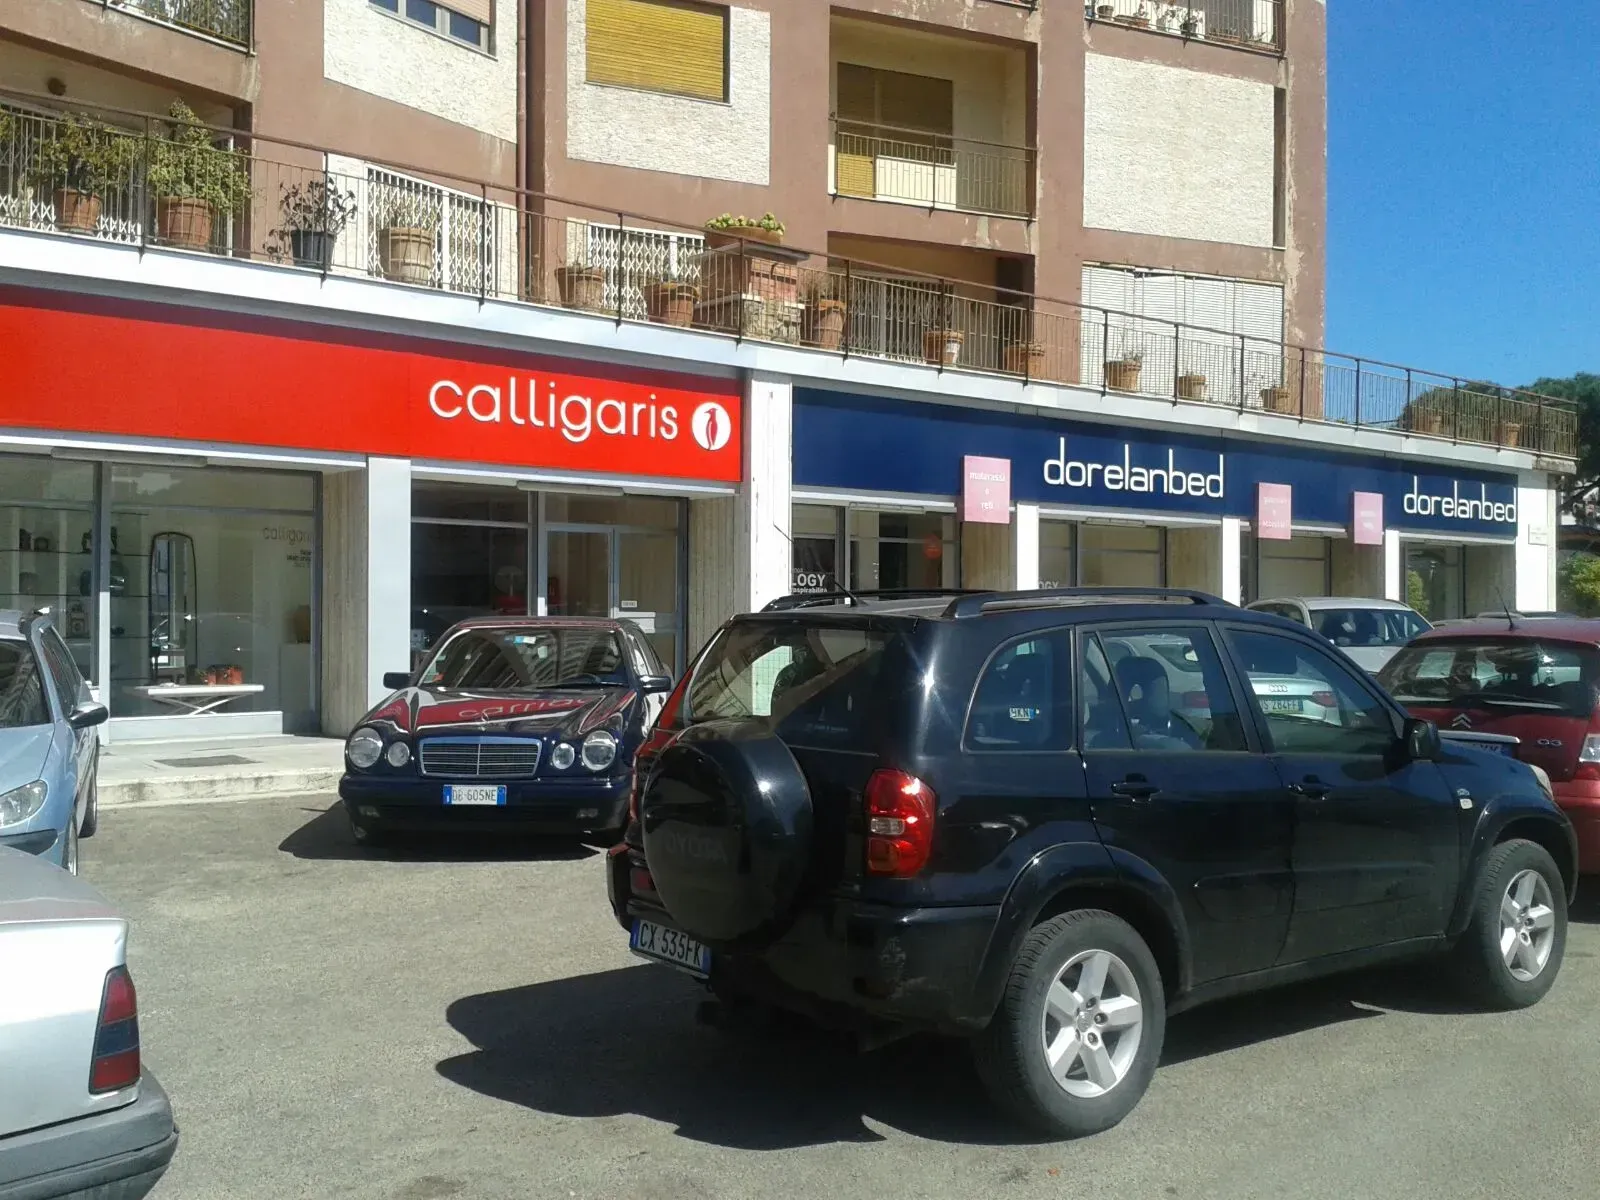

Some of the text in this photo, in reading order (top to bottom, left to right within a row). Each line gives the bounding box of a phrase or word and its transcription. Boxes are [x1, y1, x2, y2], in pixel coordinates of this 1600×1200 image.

[429, 376, 679, 443] calligaris
[1043, 436, 1224, 498] dorelanbed
[1403, 475, 1517, 523] dorelanbed
[640, 922, 658, 952] CX
[660, 928, 701, 968] 535FK
